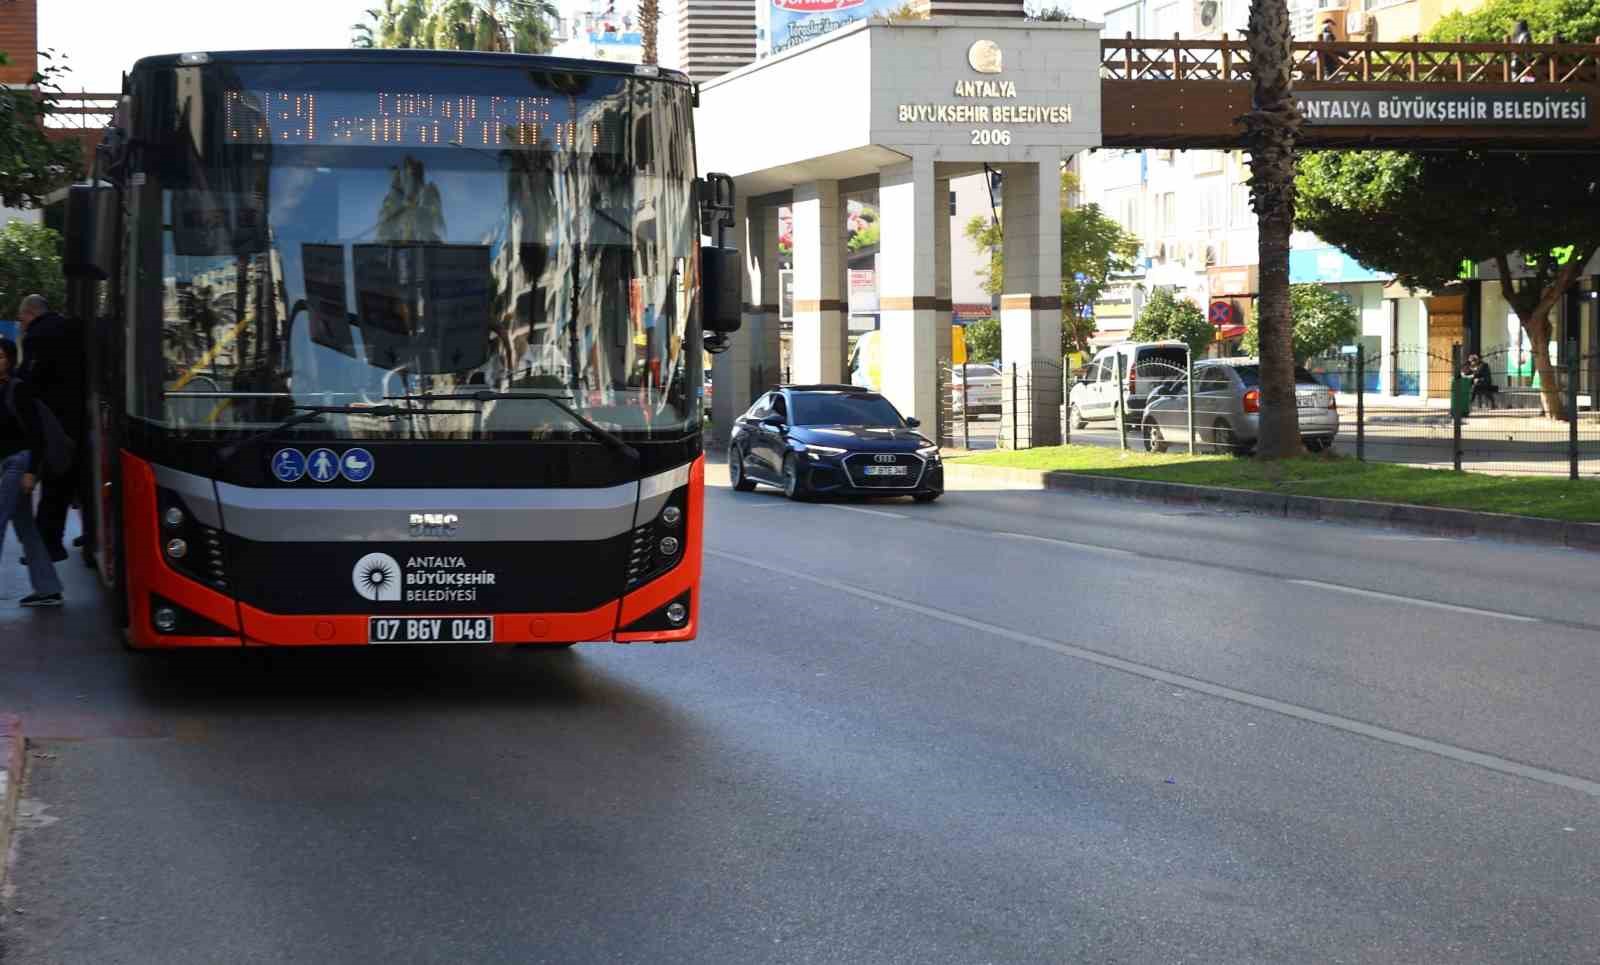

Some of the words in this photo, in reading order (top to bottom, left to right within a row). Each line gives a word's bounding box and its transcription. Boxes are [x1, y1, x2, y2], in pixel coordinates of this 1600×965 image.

[955, 80, 1016, 98] ANTALYA
[1378, 96, 1487, 121] BÜYÜKŞEHİR
[1493, 97, 1586, 119] BELEDİYESİ
[971, 129, 1011, 146] 2006
[406, 556, 466, 568] ANTALYA
[406, 570, 496, 587] BÜYÜKŞEHİR
[406, 587, 476, 602] BELEDİYESİ
[376, 619, 400, 640] 07
[407, 619, 441, 640] BGV
[452, 619, 486, 640] 048
